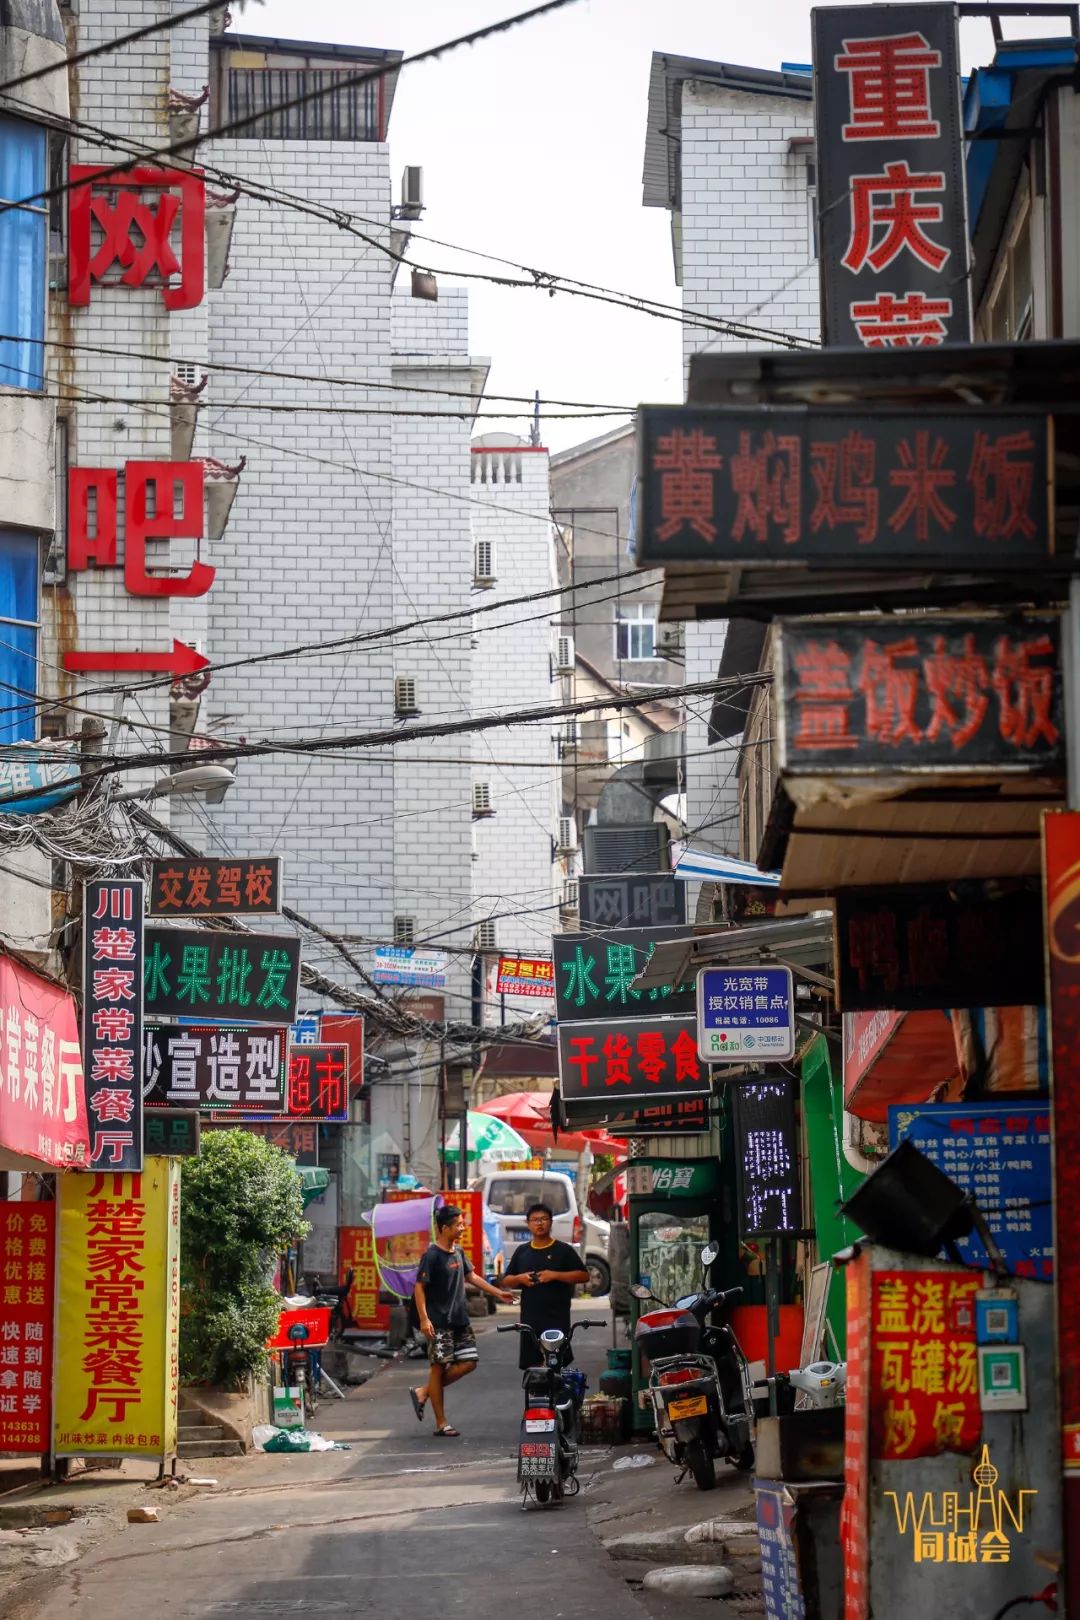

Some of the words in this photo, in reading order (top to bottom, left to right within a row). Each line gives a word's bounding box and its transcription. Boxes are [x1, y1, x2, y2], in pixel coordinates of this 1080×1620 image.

[68, 164, 215, 598] 网吧
[653, 427, 1037, 545] 黄焖鸡米饭
[793, 633, 1059, 750] 盖饭炒饭
[159, 864, 273, 908] 交发驾校
[588, 881, 678, 926] 网吧
[144, 942, 292, 1010] 水果批发
[561, 943, 680, 1007] 水果
[708, 995, 784, 1011] 授权销售点
[723, 977, 769, 992] 光宽带
[90, 887, 136, 1163] 川楚家常菜餐厅
[289, 1052, 344, 1116] 超市
[568, 1028, 700, 1088] 干货零食
[653, 1167, 695, 1189] 怡寶
[4, 1213, 24, 1305] 价格优惠
[26, 1214, 48, 1305] 免费接送
[79, 1173, 146, 1423] 川楚家常菜餐厅
[22, 1321, 44, 1414] 随到随学
[877, 1340, 977, 1395] 瓦罐汤
[885, 1400, 965, 1454] 炒饭
